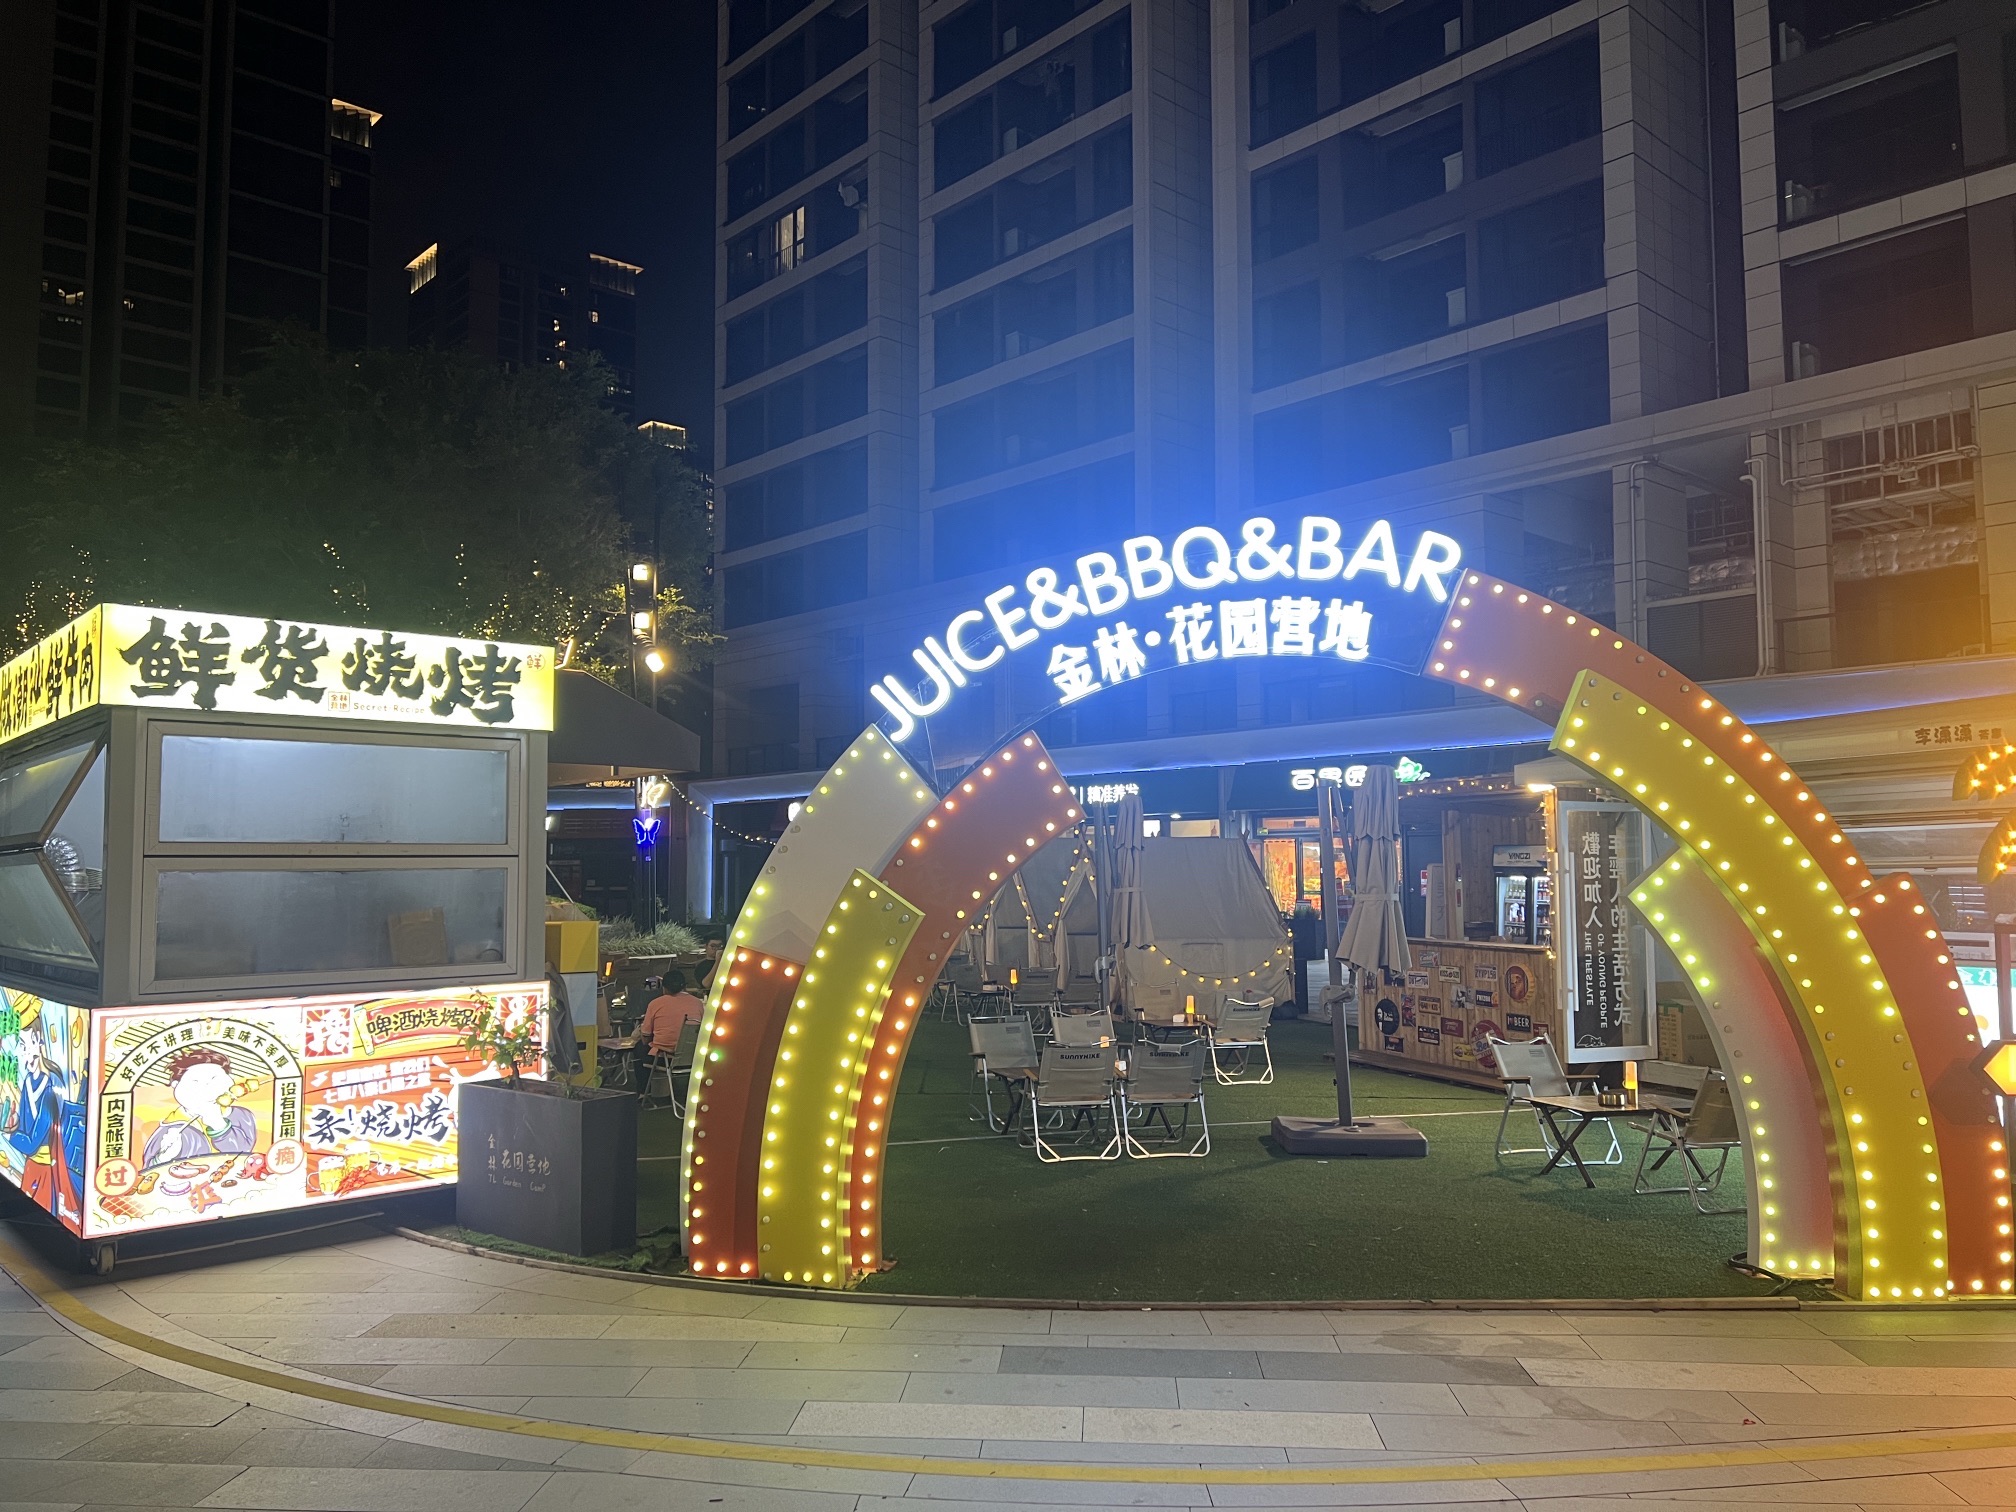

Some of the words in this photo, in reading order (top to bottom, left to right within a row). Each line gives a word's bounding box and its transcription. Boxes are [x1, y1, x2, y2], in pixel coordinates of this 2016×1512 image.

[869, 515, 1462, 743] JUICE&BBQ&BAR
[116, 616, 522, 725] 鲜货烧烤
[1513, 1017, 1530, 1028] BEER
[119, 1027, 194, 1082] 好吃不讲理
[105, 1099, 125, 1159] 内含帐篷
[279, 1082, 297, 1138] 设有包厢
[105, 1166, 128, 1188] 过
